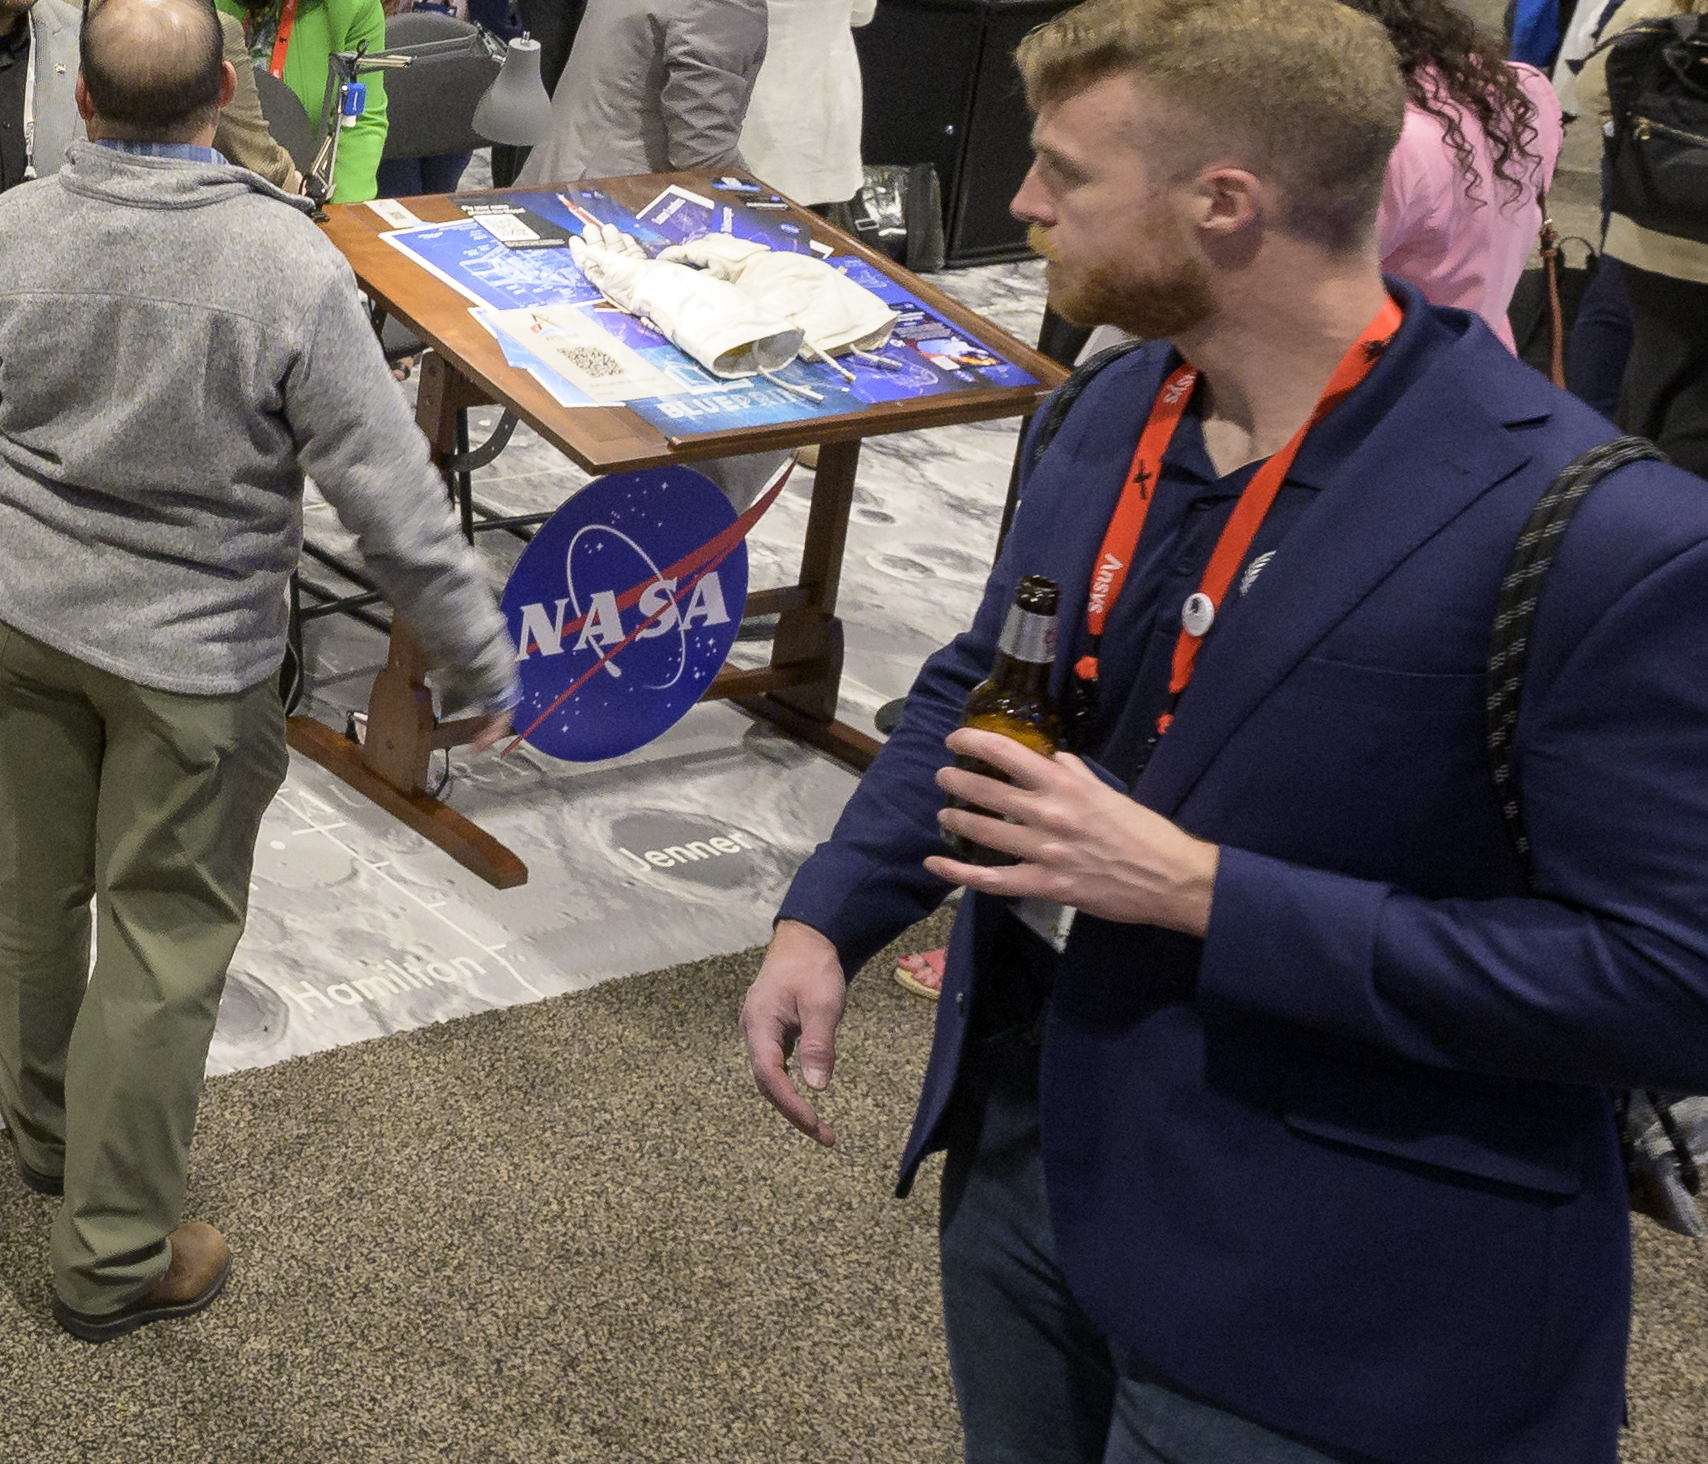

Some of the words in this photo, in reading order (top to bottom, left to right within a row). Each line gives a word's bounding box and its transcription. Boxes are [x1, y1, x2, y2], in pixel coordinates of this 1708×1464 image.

[1088, 552, 1114, 614] Ansys
[514, 570, 731, 662] NASA
[619, 832, 752, 872] Jenner
[281, 954, 486, 1013] Hamilton
